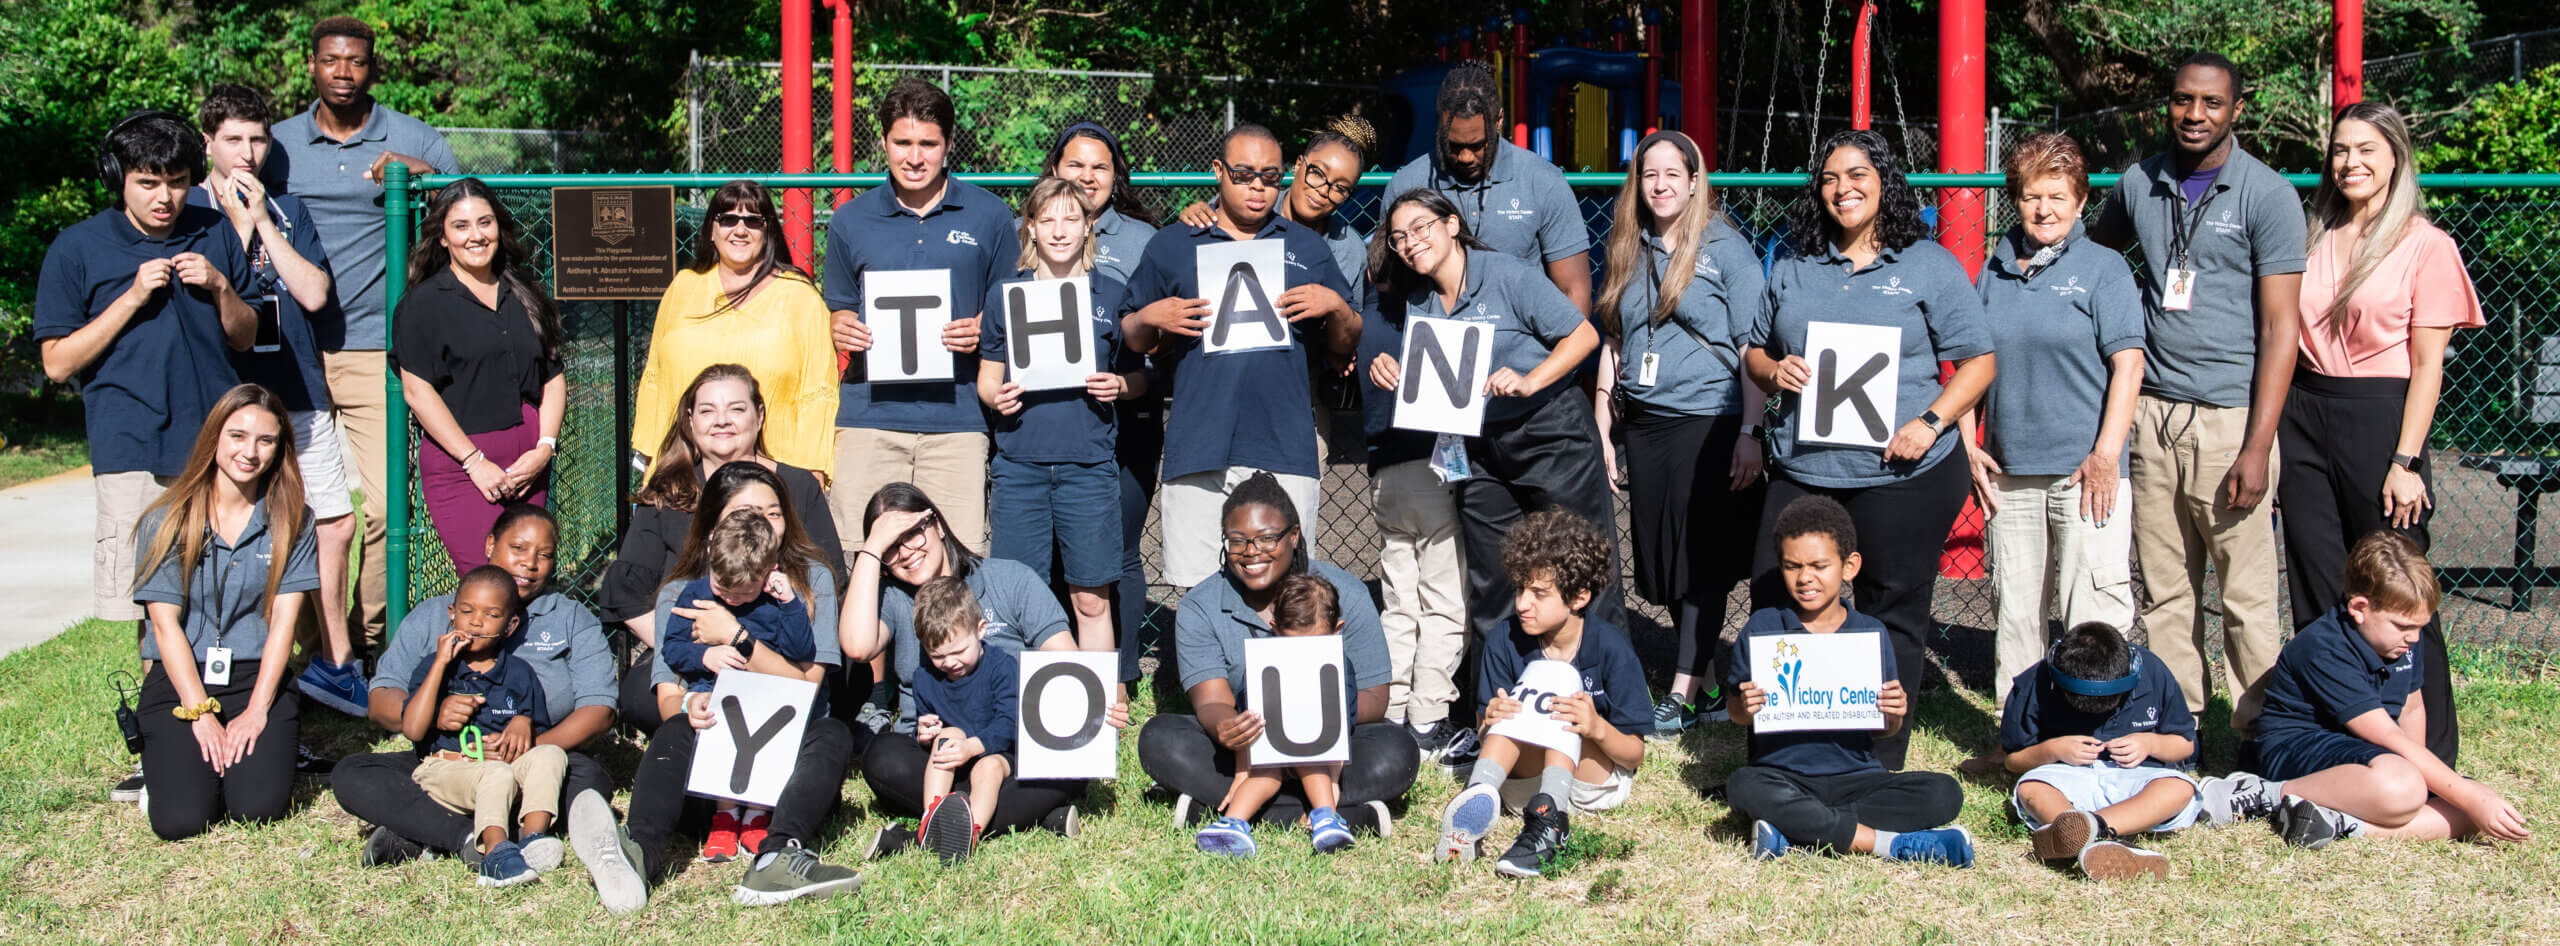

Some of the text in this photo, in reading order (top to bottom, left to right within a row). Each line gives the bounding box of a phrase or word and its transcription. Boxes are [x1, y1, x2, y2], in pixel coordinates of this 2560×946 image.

[875, 296, 942, 375] T
[1009, 282, 1081, 369] H
[1212, 262, 1285, 346] A
[1403, 321, 1480, 409] N
[1815, 349, 1889, 443] K
[1022, 662, 1106, 751] O
[1262, 664, 1341, 757] U
[1758, 710, 1881, 722] FOR AUTISM AND RELATED DISABILITIES
[1840, 686, 1878, 705] Cente
[722, 696, 796, 795] Y
